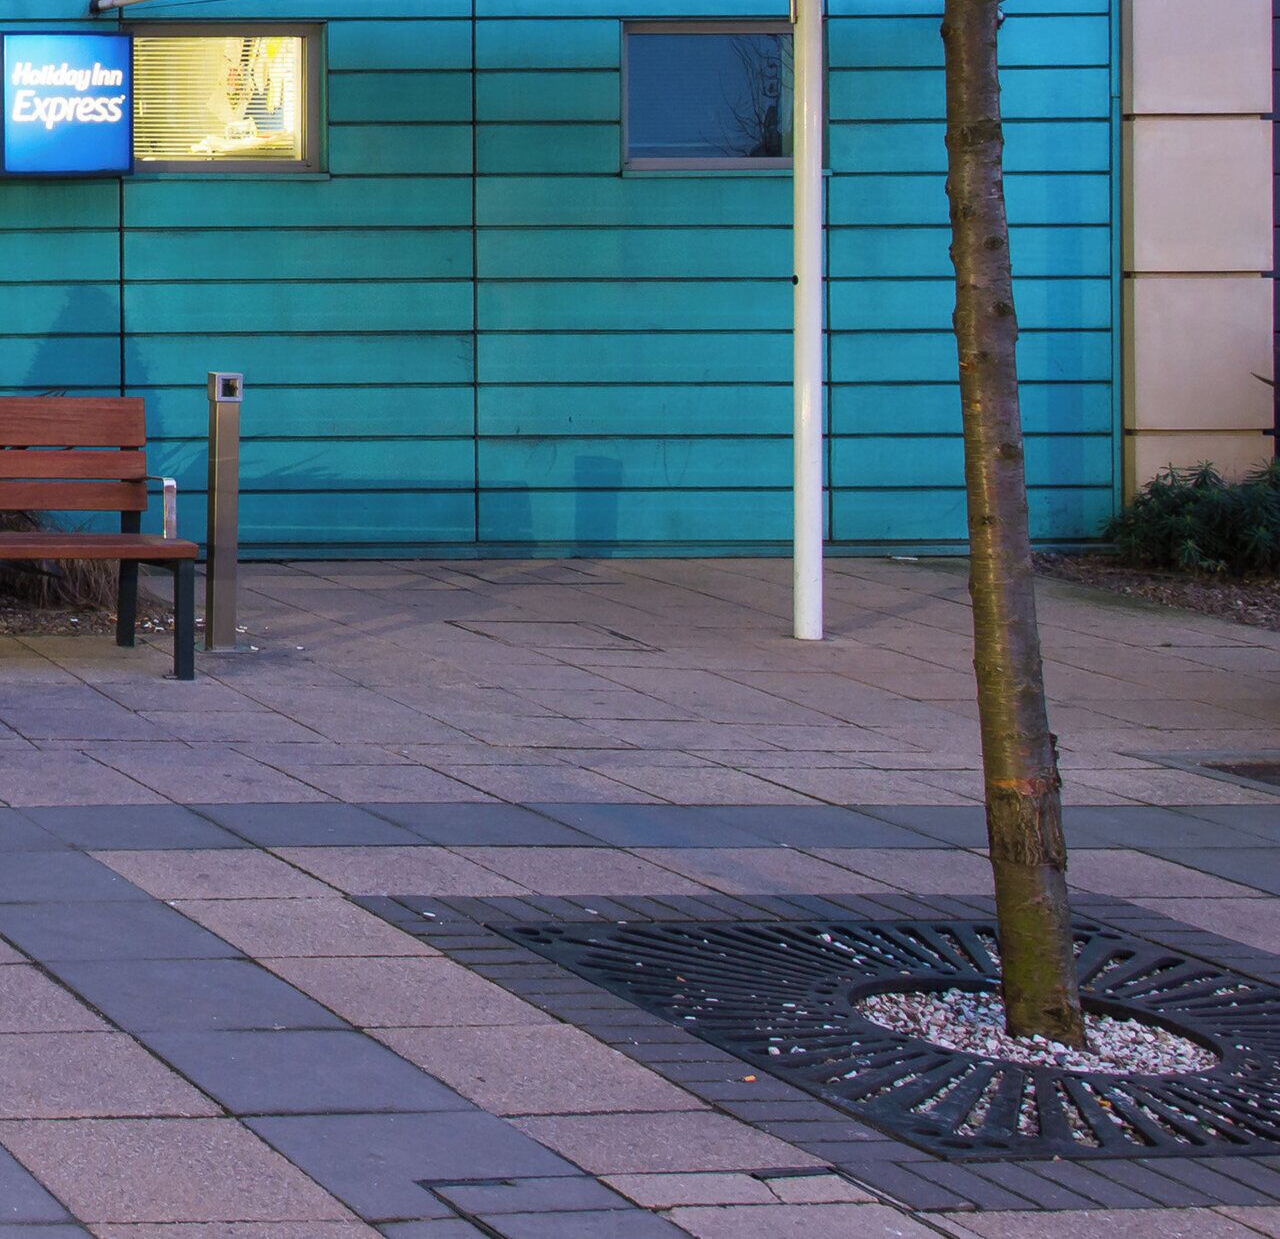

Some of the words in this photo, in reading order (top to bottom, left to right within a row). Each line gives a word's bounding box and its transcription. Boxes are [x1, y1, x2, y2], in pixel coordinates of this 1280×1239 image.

[12, 62, 91, 91] Holiday
[91, 62, 123, 86] Inn
[12, 89, 123, 130] Express
